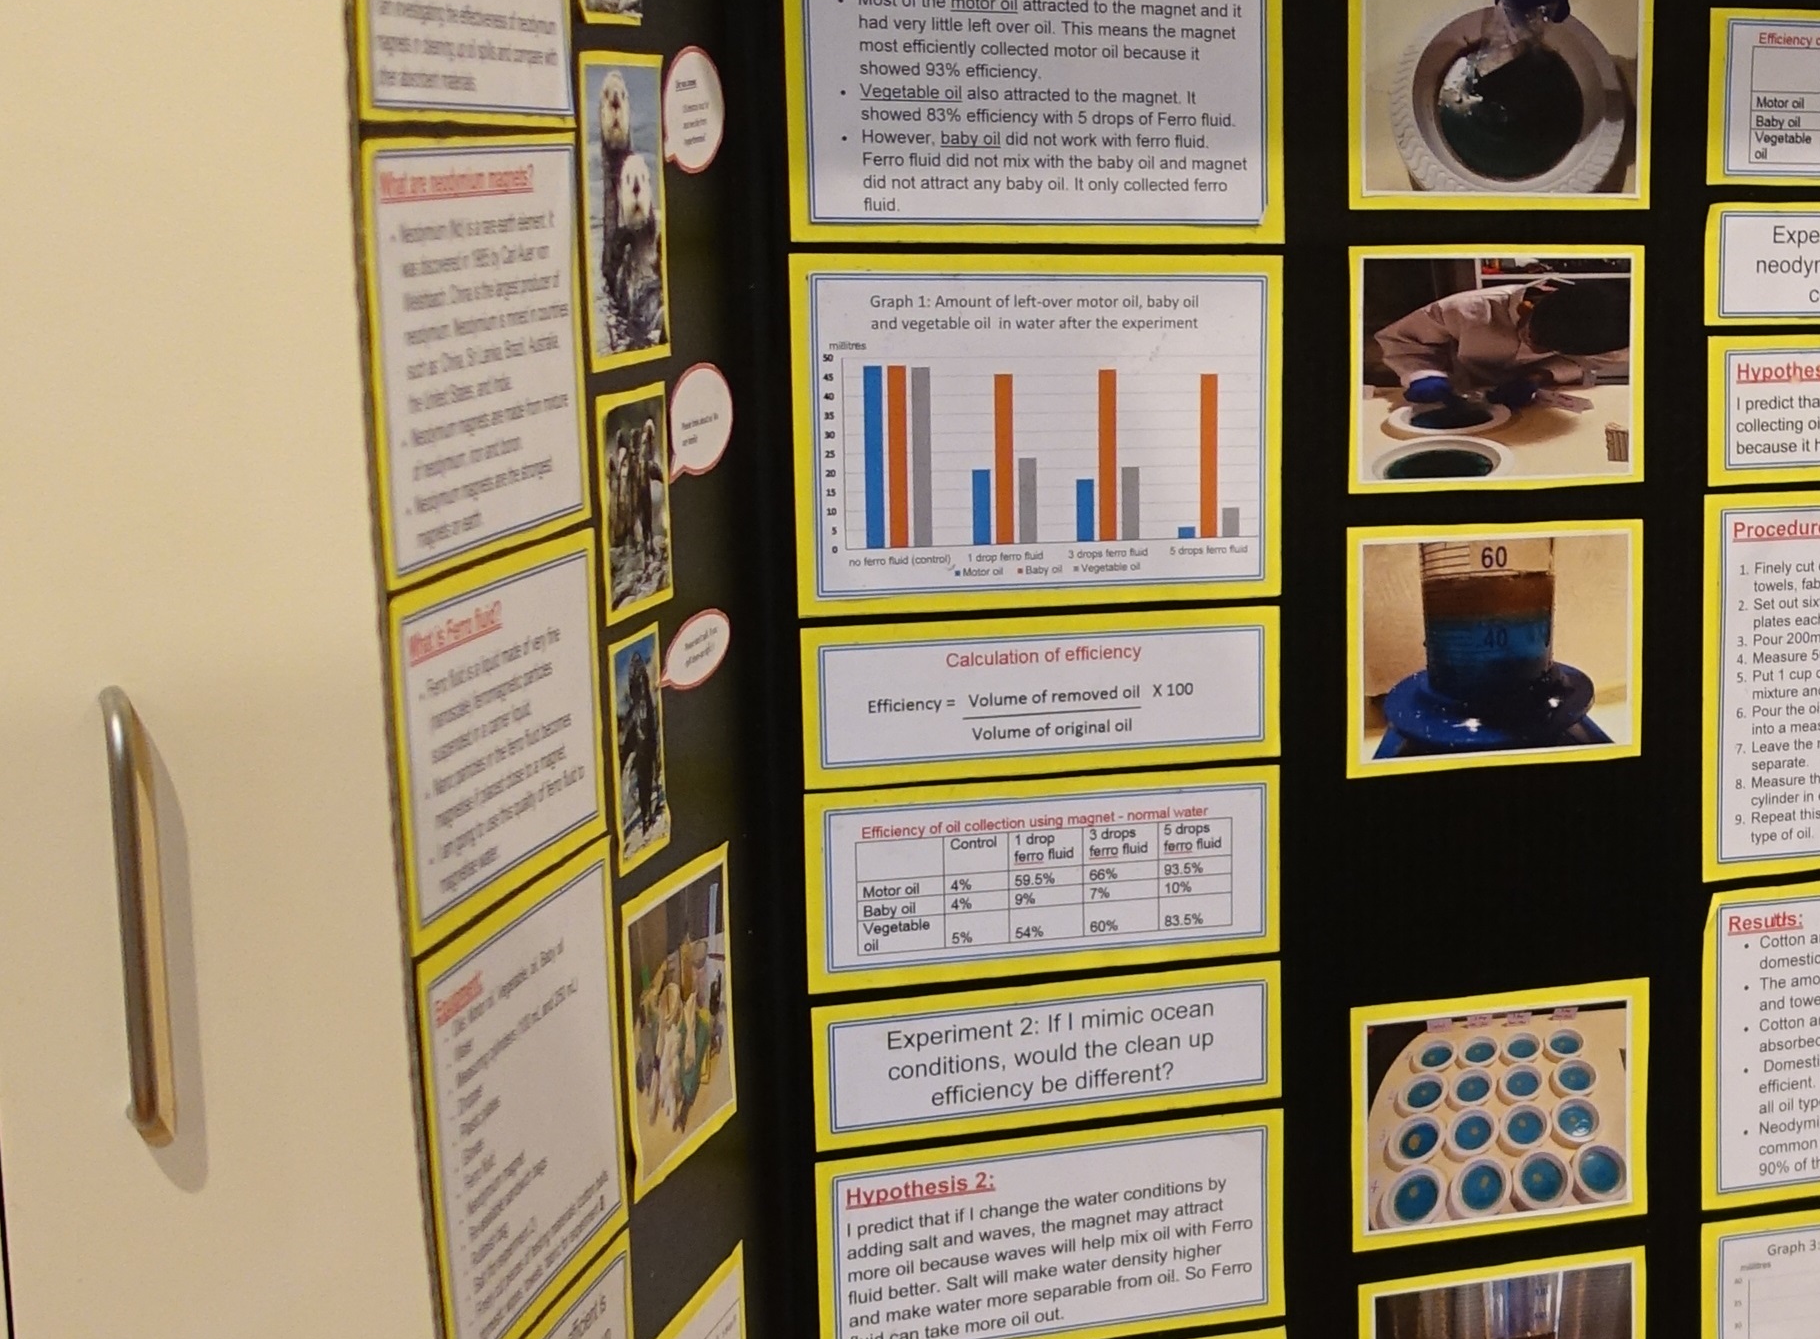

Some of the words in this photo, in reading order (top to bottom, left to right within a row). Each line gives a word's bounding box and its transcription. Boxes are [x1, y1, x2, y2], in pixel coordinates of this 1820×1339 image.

[861, 106, 921, 121] showed
[926, 107, 961, 122] 83%
[966, 108, 1038, 127] efficiency
[1042, 109, 1073, 124] with
[1078, 110, 1087, 124] 5
[1091, 110, 1134, 128] drops
[1138, 111, 1154, 125] of
[1157, 111, 1197, 126] Ferro
[1201, 112, 1236, 127] fluid.
[869, 294, 913, 310] Graph
[918, 295, 930, 308] 1:
[935, 295, 992, 312] Amount
[995, 294, 1010, 308] of
[1013, 294, 1073, 308] left-over
[1076, 296, 1119, 308] motor
[1122, 294, 1143, 310] oil,
[1147, 294, 1179, 310] baby
[1183, 294, 1198, 308] oil
[1481, 546, 1508, 569] 60
[962, 567, 988, 577] Motor
[992, 567, 1003, 576] oil
[1025, 566, 1049, 577] Baby
[1052, 565, 1063, 575] oil
[1081, 563, 1128, 574] Vegetable
[1130, 562, 1141, 572] oil
[1736, 635, 1747, 647] 3.
[1753, 633, 1784, 646] Pour
[946, 649, 1039, 668] Calculation
[1044, 647, 1061, 662] of
[1065, 645, 1141, 662] efficiency
[968, 692, 1027, 707] Volume
[1031, 689, 1047, 704] of
[1051, 685, 1118, 702] removed
[1122, 684, 1140, 699] oil
[1152, 684, 1162, 697] X
[1167, 682, 1193, 696] 100
[868, 698, 942, 713] Efficiency
[971, 725, 1030, 740] Volume
[1035, 722, 1051, 737] of
[1054, 719, 1110, 738] original
[1114, 718, 1132, 732] oil
[863, 883, 900, 899] Motor
[905, 883, 920, 897] oil
[951, 880, 971, 892] 4%
[1015, 873, 1055, 886] 59.5%
[1089, 869, 1117, 881] 66%
[1164, 862, 1203, 875] 93.5%
[887, 1019, 1013, 1052] Experiment
[1020, 1017, 1038, 1036] 2:
[1048, 1013, 1061, 1033] If
[1068, 1012, 1072, 1030] I
[1081, 1006, 1143, 1029] mimic
[1150, 1002, 1213, 1022] ocean
[888, 1054, 1005, 1081] conditions,
[1014, 1041, 1076, 1066] would
[1084, 1039, 1117, 1059] the
[1125, 1035, 1180, 1054] clean
[1189, 1032, 1213, 1051] up
[931, 1081, 1033, 1106] efficiency
[1041, 1075, 1067, 1094] be
[1075, 1061, 1173, 1090] different?
[846, 1176, 968, 1207] Hypothesis
[976, 1172, 995, 1191] 2:
[1767, 1240, 1805, 1256] Graph
[1809, 1239, 1820, 1251] 3:
